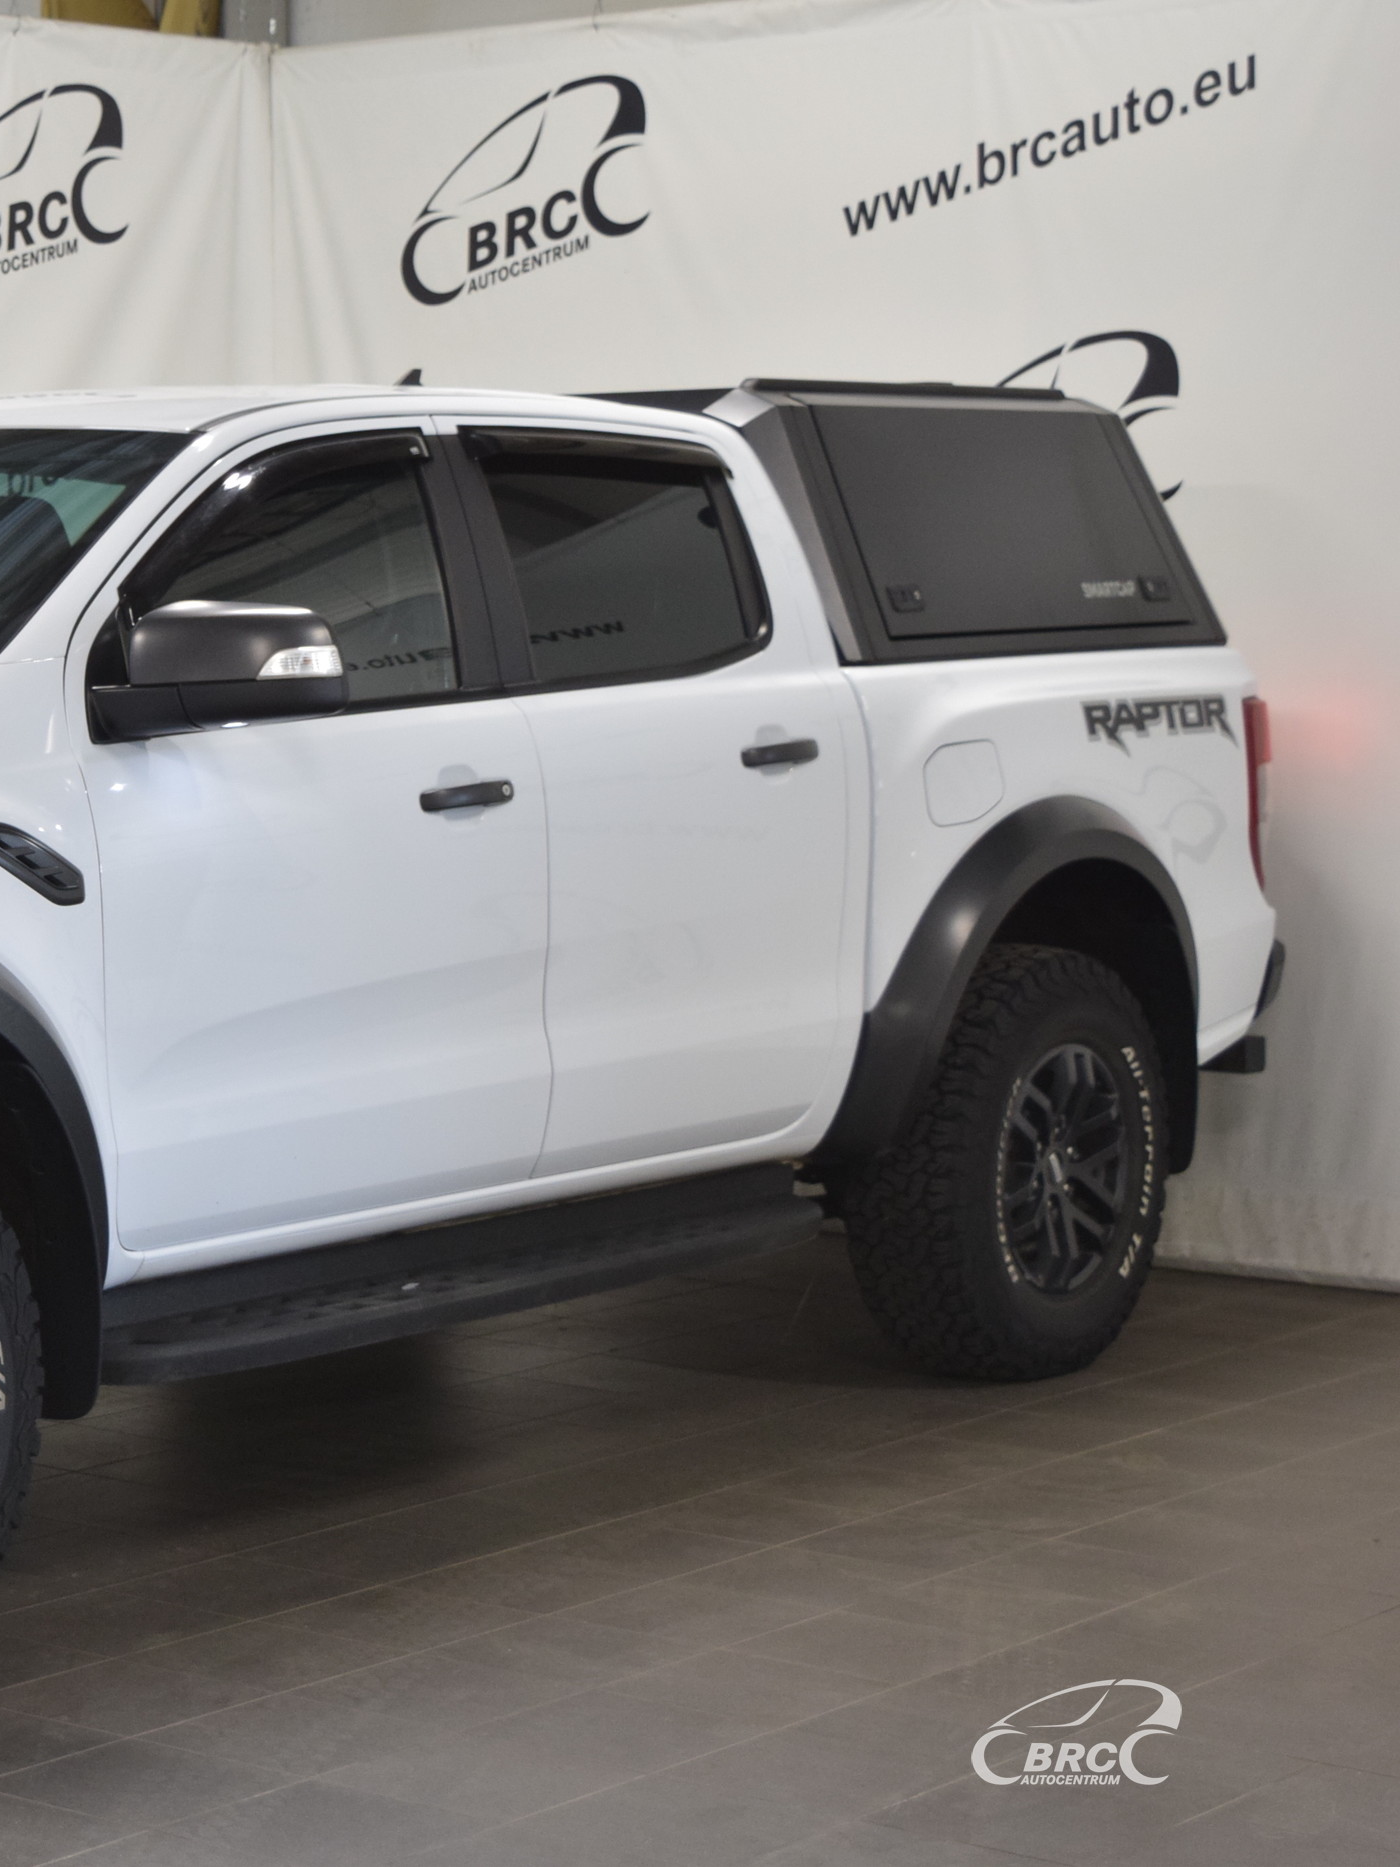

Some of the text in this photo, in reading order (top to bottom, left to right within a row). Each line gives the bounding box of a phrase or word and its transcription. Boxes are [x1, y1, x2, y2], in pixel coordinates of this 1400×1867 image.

[842, 54, 1257, 238] www.brcauto.eu
[466, 189, 579, 273] BRC
[466, 233, 591, 295] AUTOCENTRUM
[1080, 694, 1240, 758] RAPTOR
[1118, 1046, 1153, 1278] All-Terrain T/A
